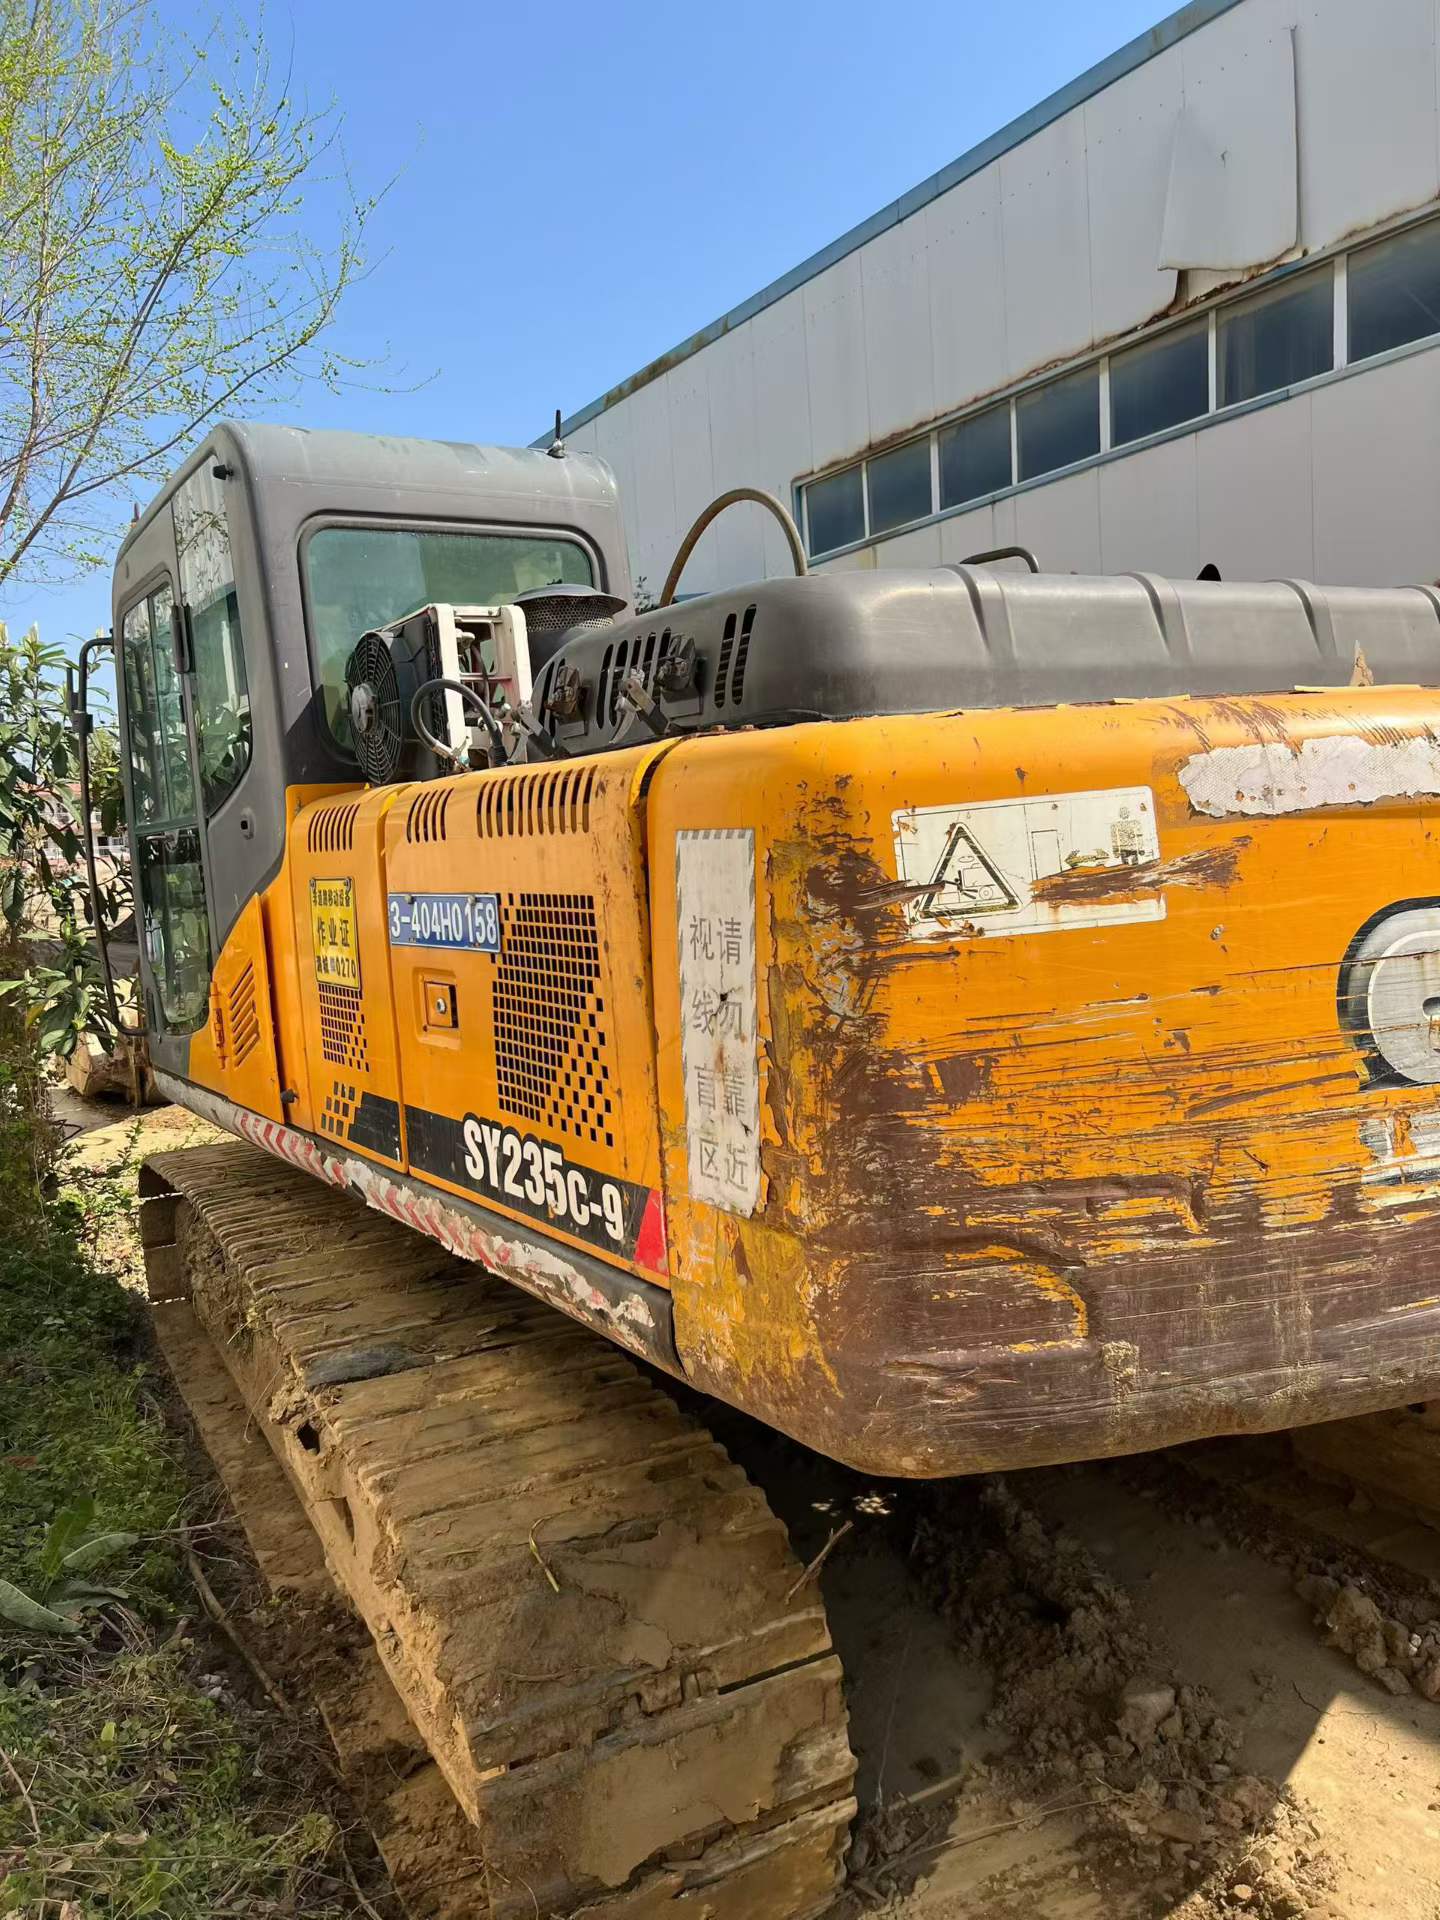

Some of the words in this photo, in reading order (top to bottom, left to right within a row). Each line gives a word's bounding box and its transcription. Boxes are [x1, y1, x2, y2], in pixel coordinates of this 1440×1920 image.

[317, 916, 350, 947] 作业证
[390, 901, 497, 945] 3-404H0158
[463, 1119, 624, 1241] SY235C-9
